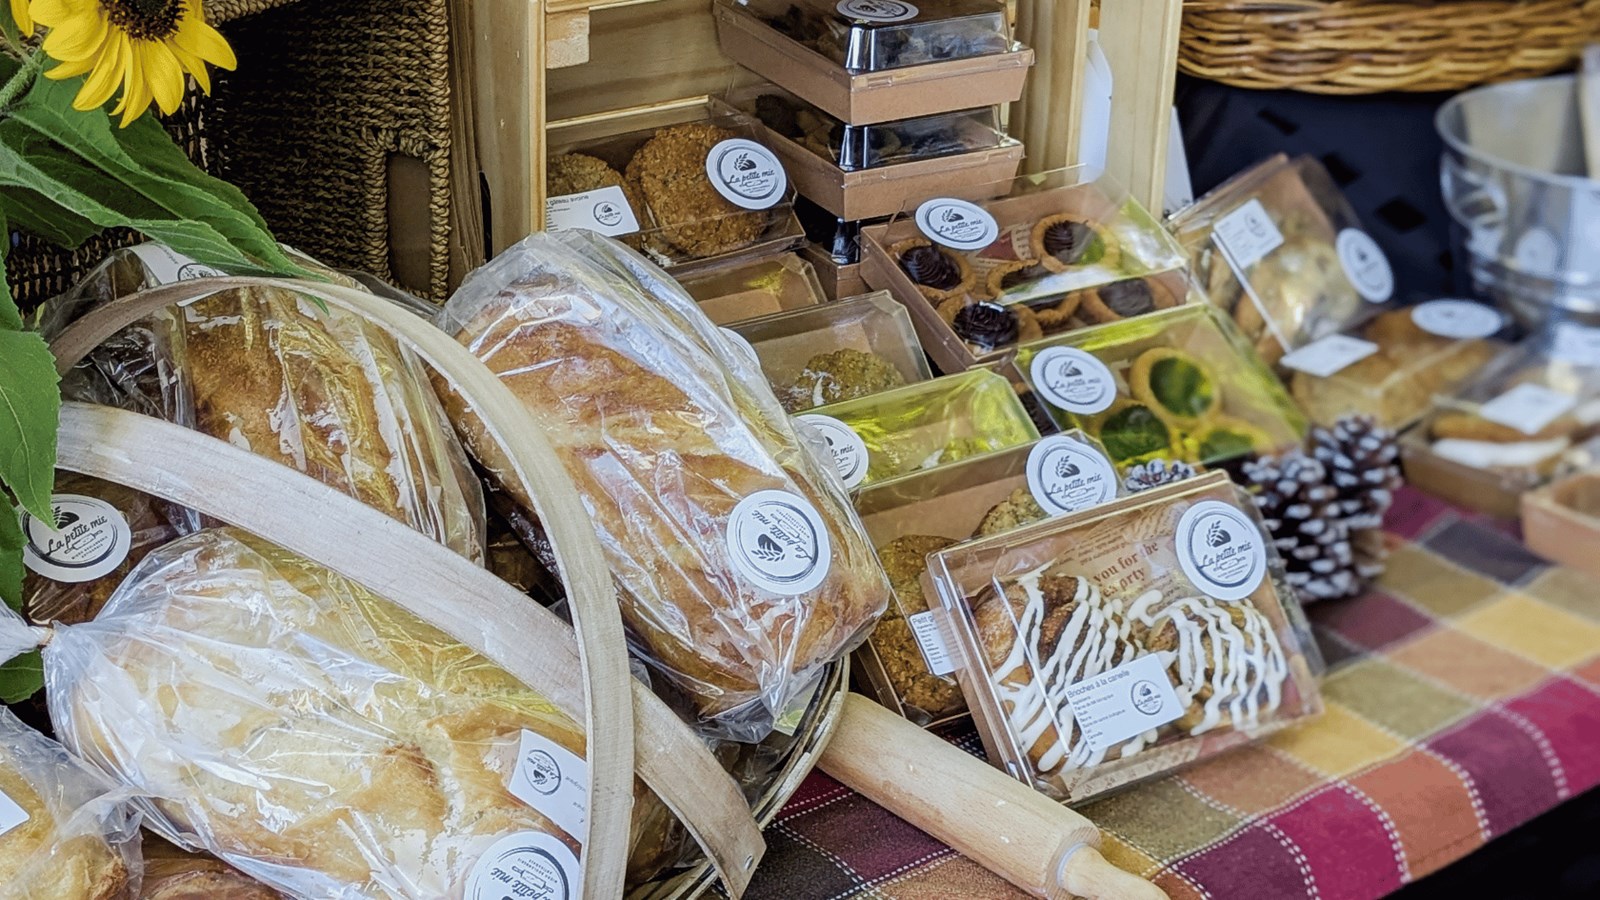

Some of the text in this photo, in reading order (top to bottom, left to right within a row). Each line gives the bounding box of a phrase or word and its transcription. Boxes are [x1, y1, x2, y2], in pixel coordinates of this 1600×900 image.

[725, 169, 775, 186] La petite mie
[938, 225, 951, 234] La
[951, 221, 970, 234] petite
[840, 443, 855, 455] mie
[1047, 472, 1103, 496] La petite mie
[45, 515, 108, 557] La petite mie
[751, 509, 813, 561] La petite mie
[1199, 539, 1253, 569] La petite mie
[1093, 564, 1119, 587] you
[1117, 552, 1138, 570] for
[1067, 683, 1095, 698] Brioches
[490, 867, 547, 900] petite mie
